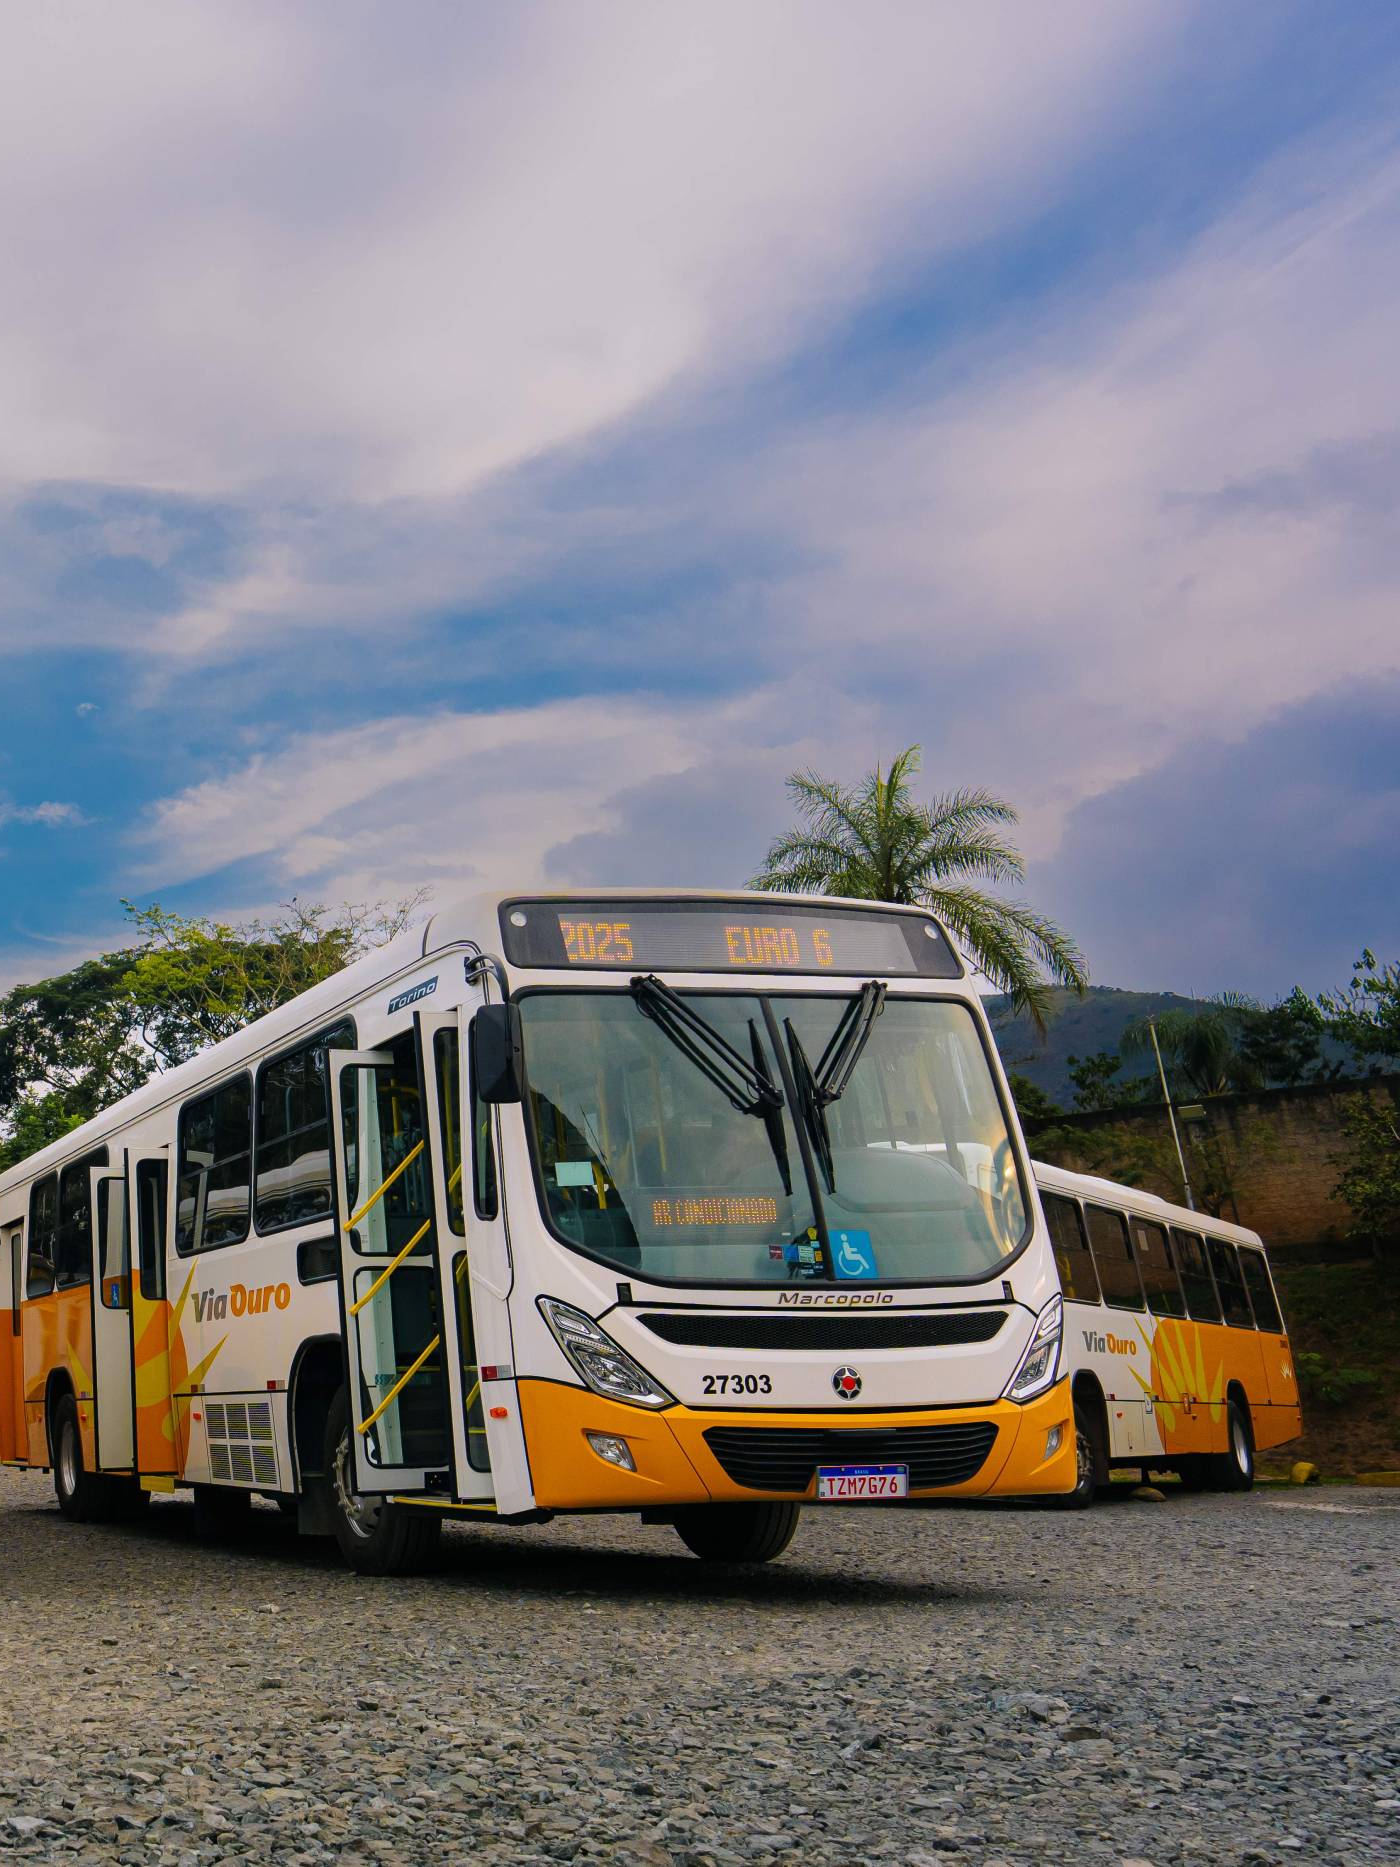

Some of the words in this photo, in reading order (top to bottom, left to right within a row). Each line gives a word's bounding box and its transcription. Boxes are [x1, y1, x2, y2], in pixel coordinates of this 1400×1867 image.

[560, 922, 634, 960] 2025
[724, 927, 800, 965] EURO
[812, 929, 833, 966] 6
[390, 982, 436, 1012] Torino
[778, 1291, 894, 1306] Marcopolo
[702, 1374, 773, 1395] 27303
[827, 1475, 899, 1496] TZM7G76
